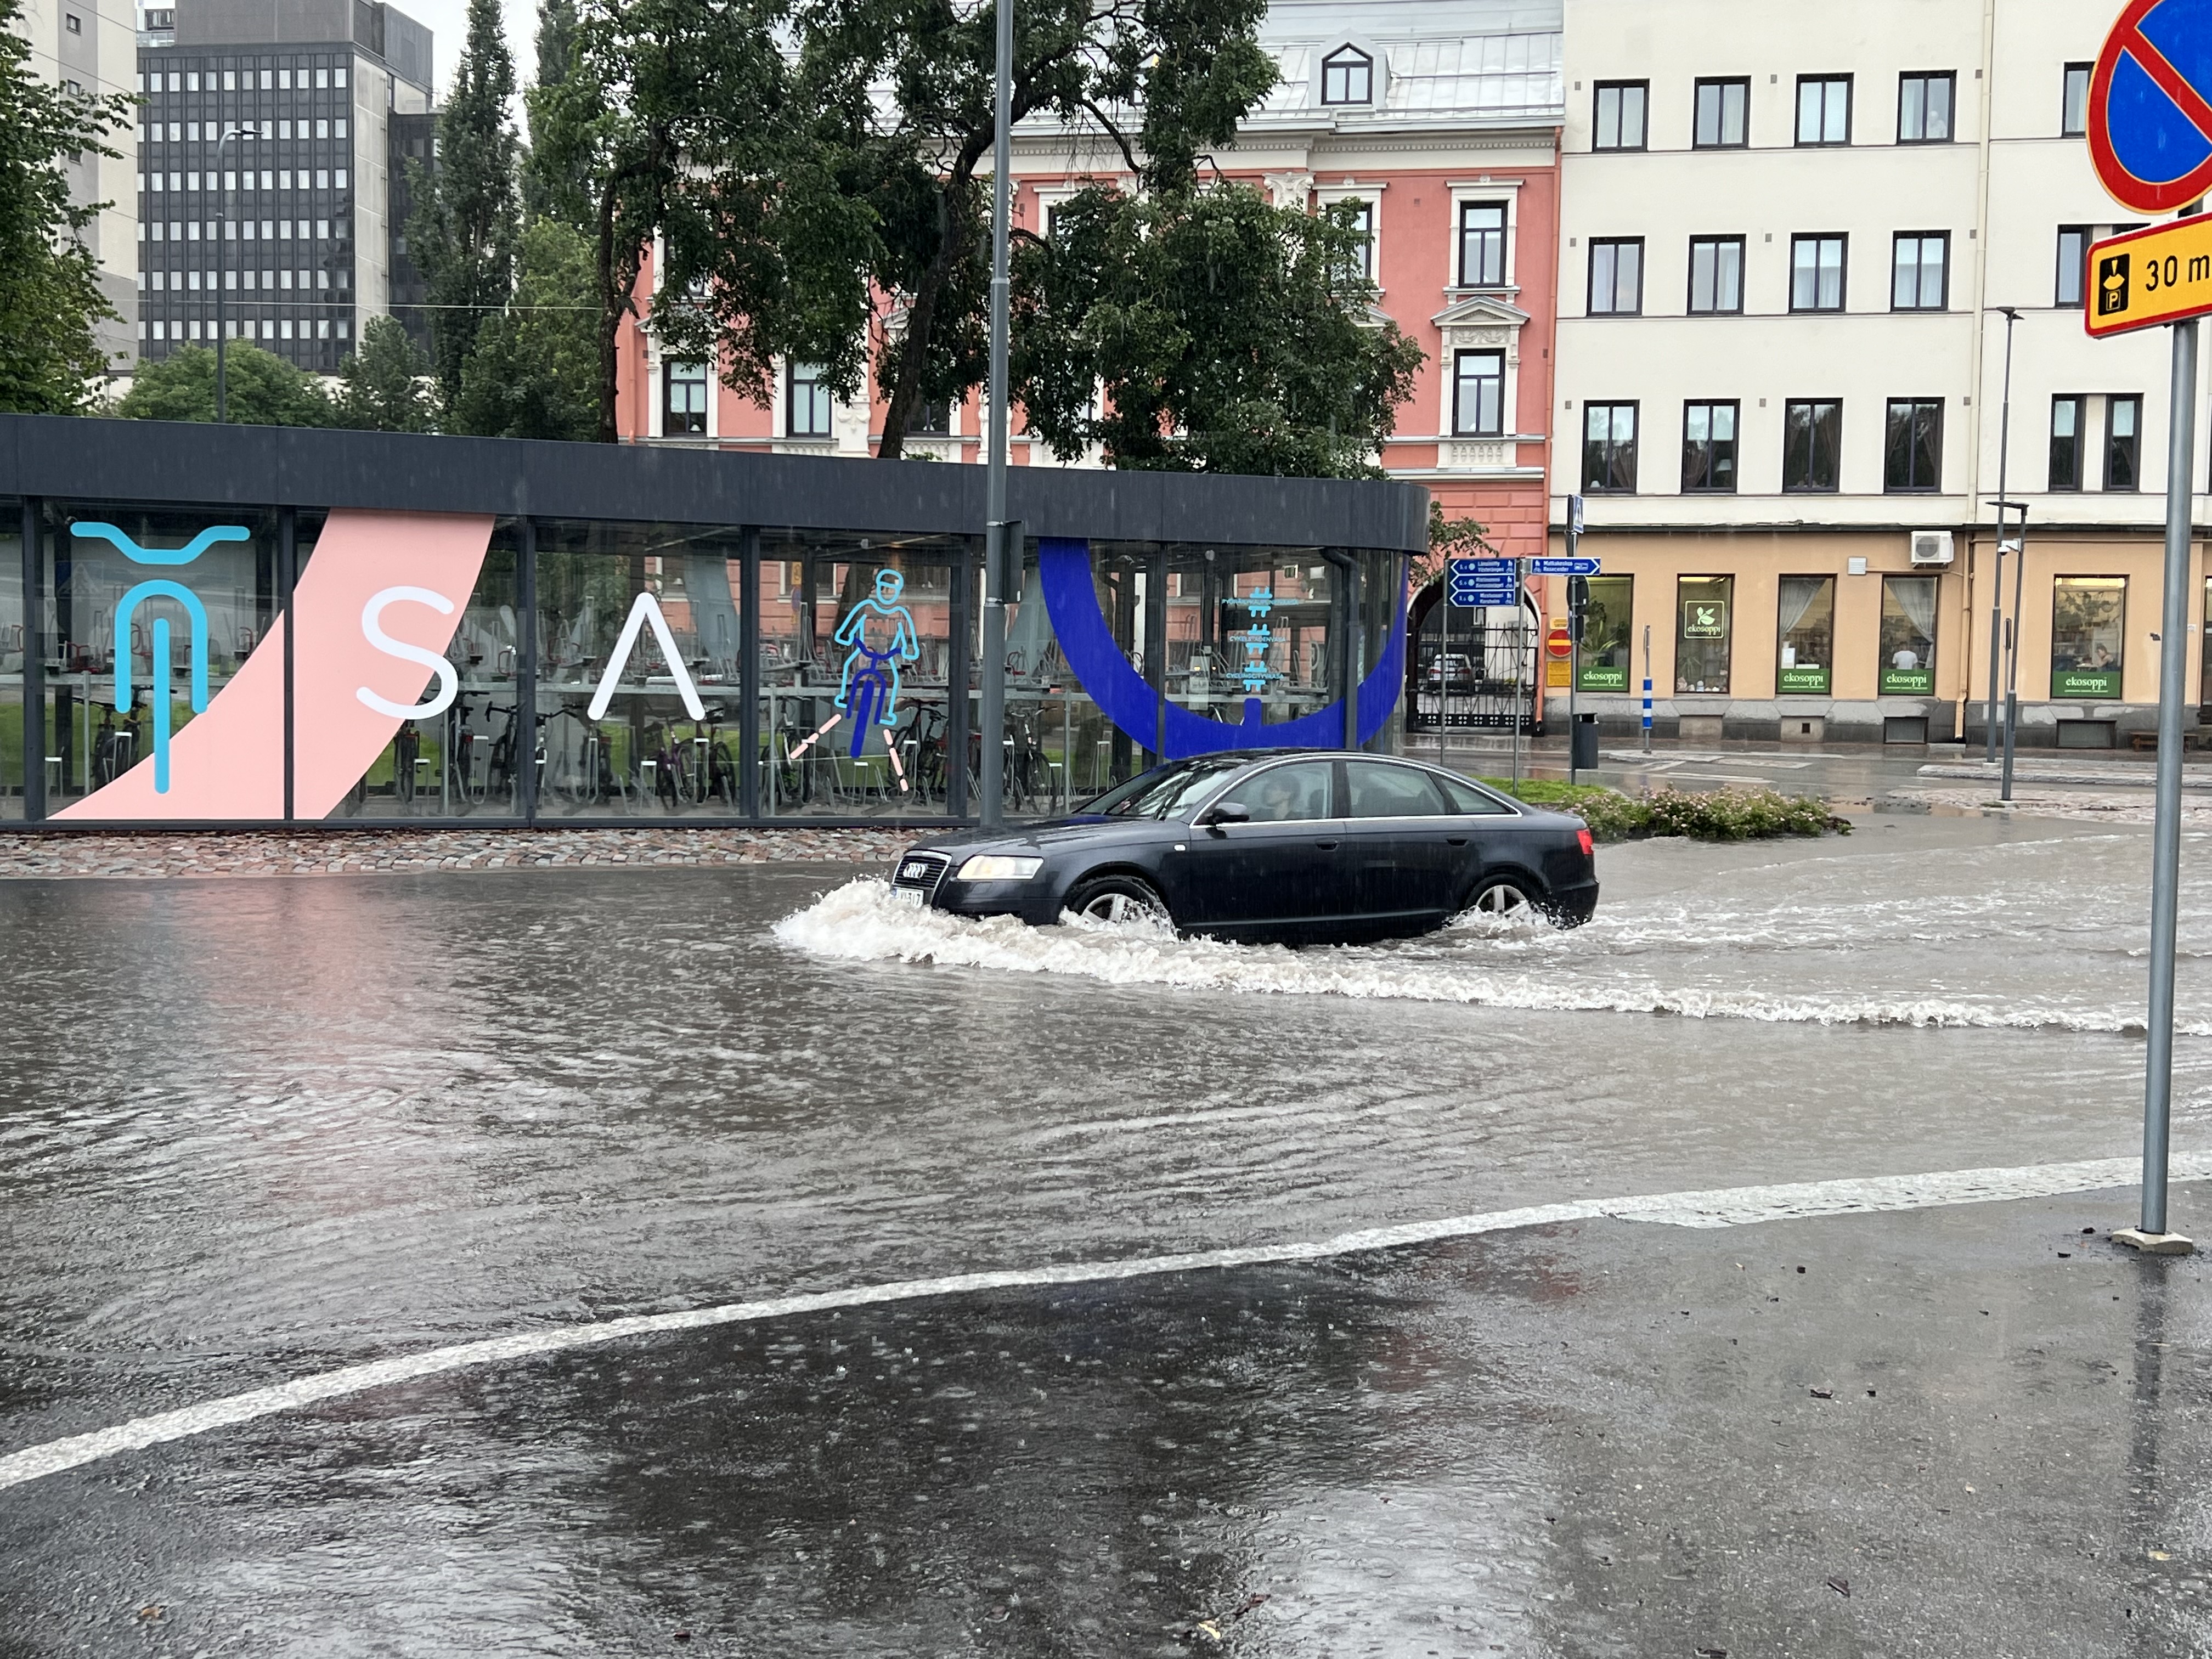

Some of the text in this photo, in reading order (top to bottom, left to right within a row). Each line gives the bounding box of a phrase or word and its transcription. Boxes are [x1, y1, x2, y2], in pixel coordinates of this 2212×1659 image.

[2146, 256, 2177, 291] 30
[2109, 292, 2118, 309] P
[1687, 624, 1721, 635] ekosoppi
[1583, 671, 1622, 684] ekosoppi
[1784, 672, 1824, 686] ekosoppi
[1886, 674, 1927, 687] ekosoppi
[2066, 676, 2107, 691] ekosoppi
